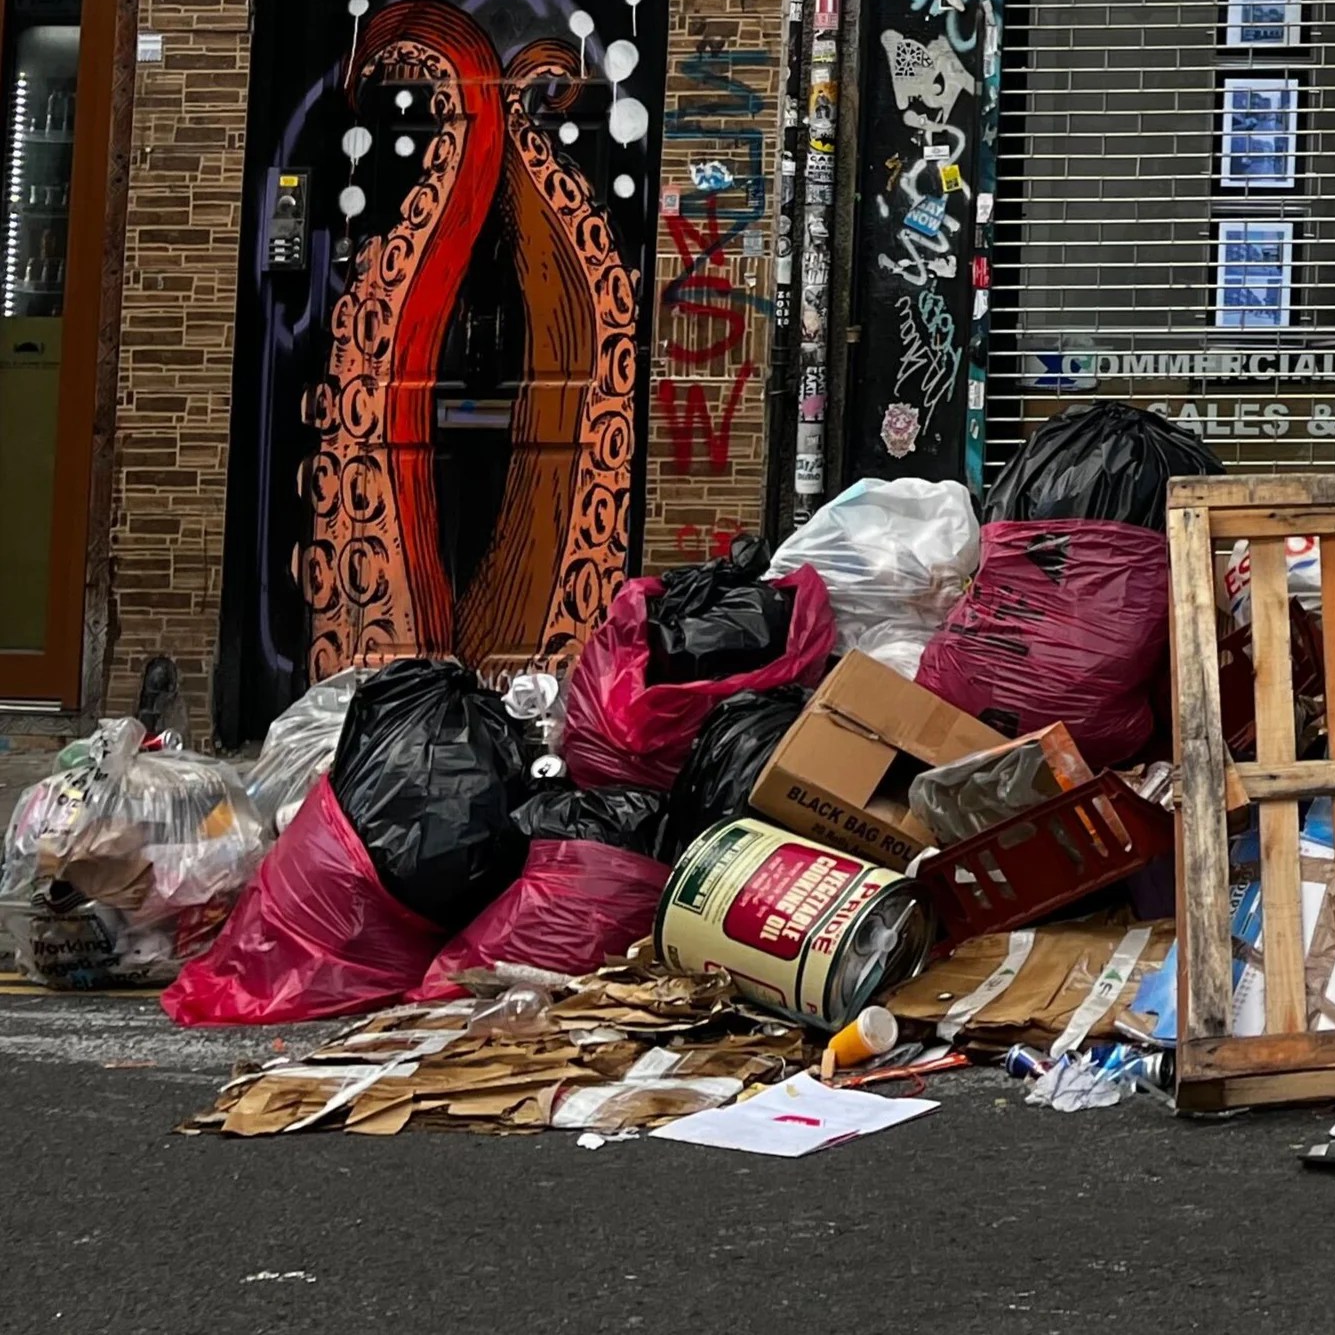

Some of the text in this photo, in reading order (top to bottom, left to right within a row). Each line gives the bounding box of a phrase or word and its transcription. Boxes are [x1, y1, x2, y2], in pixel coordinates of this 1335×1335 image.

[1303, 402, 1335, 435] &
[785, 785, 844, 828] BLACK
[844, 812, 886, 848] BAG
[775, 855, 838, 915] COOKING
[782, 869, 850, 942] VEGETABLE
[759, 913, 788, 943] OIL
[811, 880, 882, 956] PRIDE
